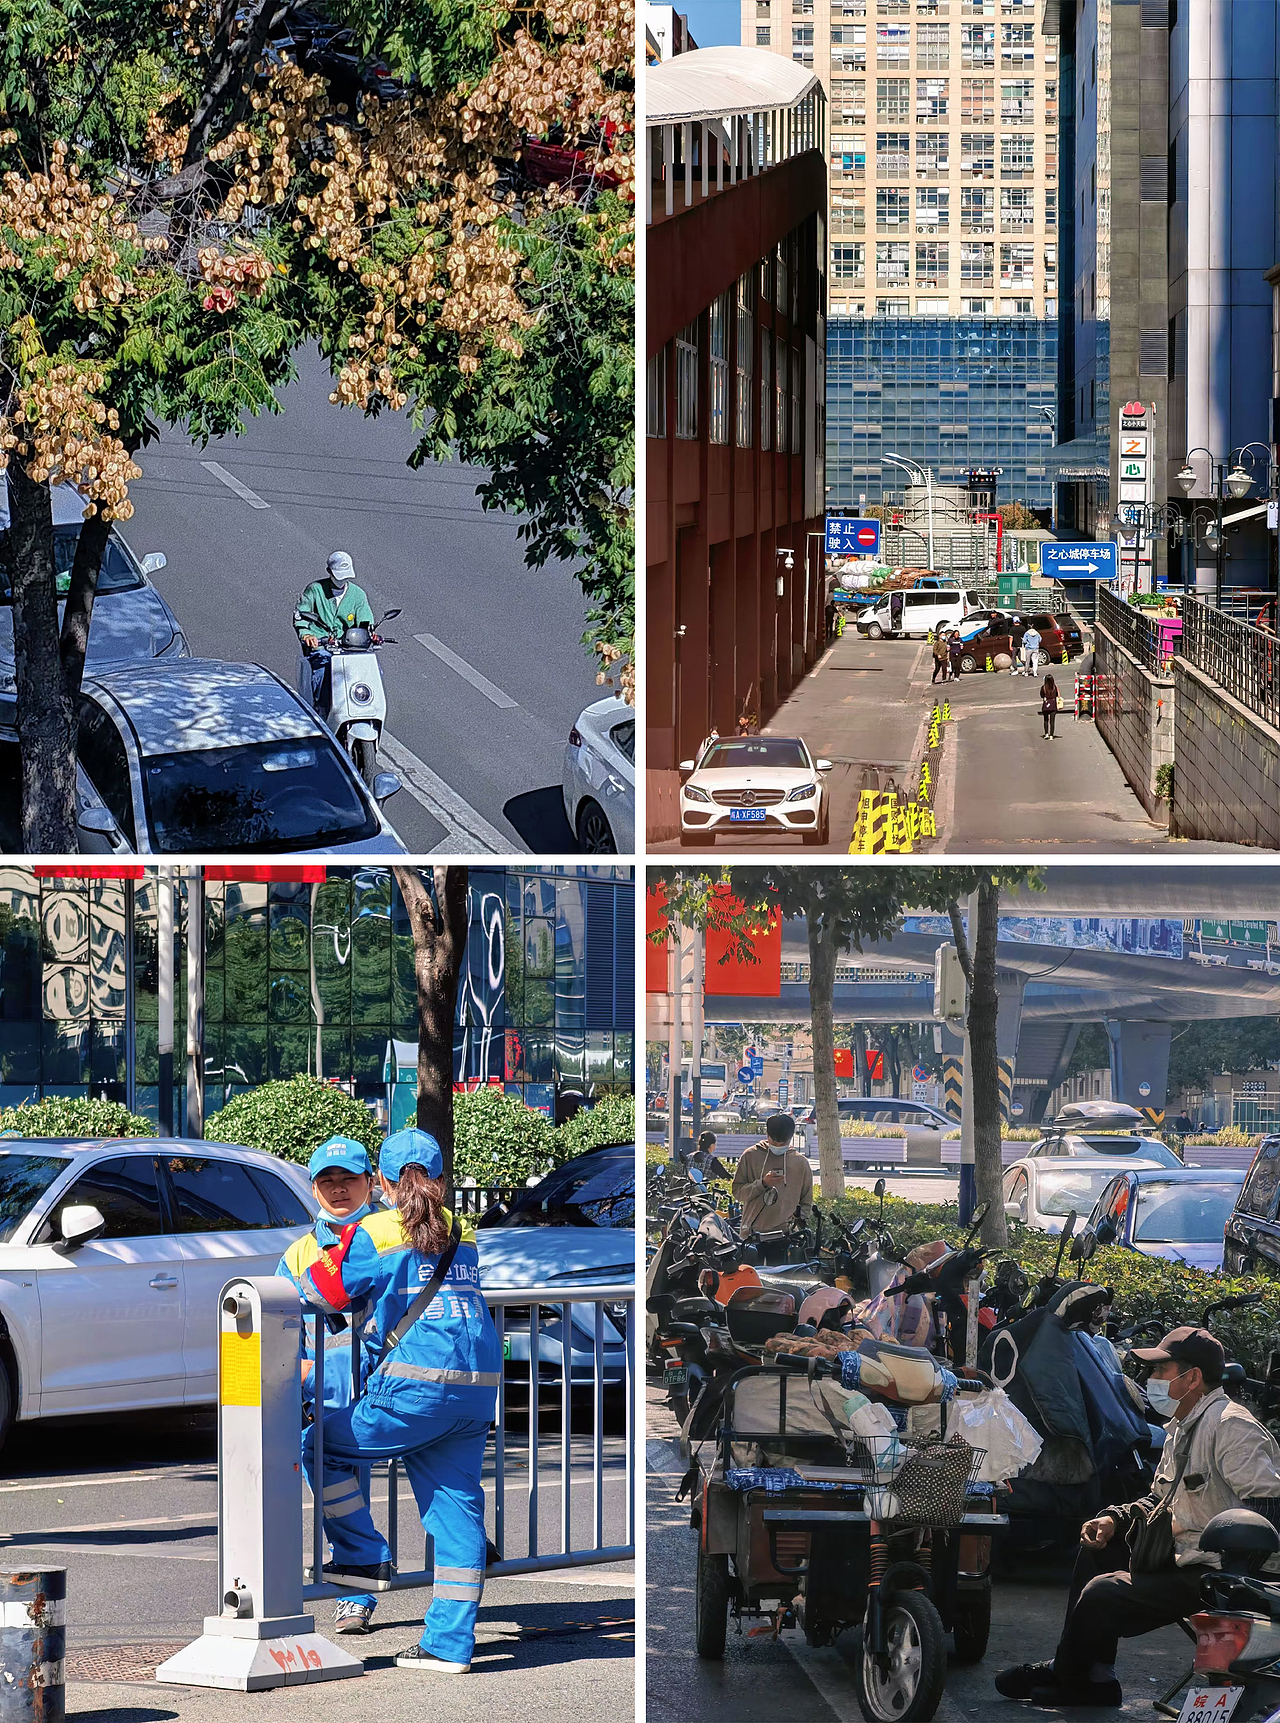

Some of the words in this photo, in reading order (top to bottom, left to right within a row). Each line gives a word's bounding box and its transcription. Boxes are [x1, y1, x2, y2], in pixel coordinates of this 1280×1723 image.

[829, 522, 855, 535] 禁止
[828, 537, 855, 550] 驶入
[1047, 548, 1111, 560] 之心城停车场
[1193, 1695, 1209, 1708] 皖
[1214, 1693, 1228, 1708] A
